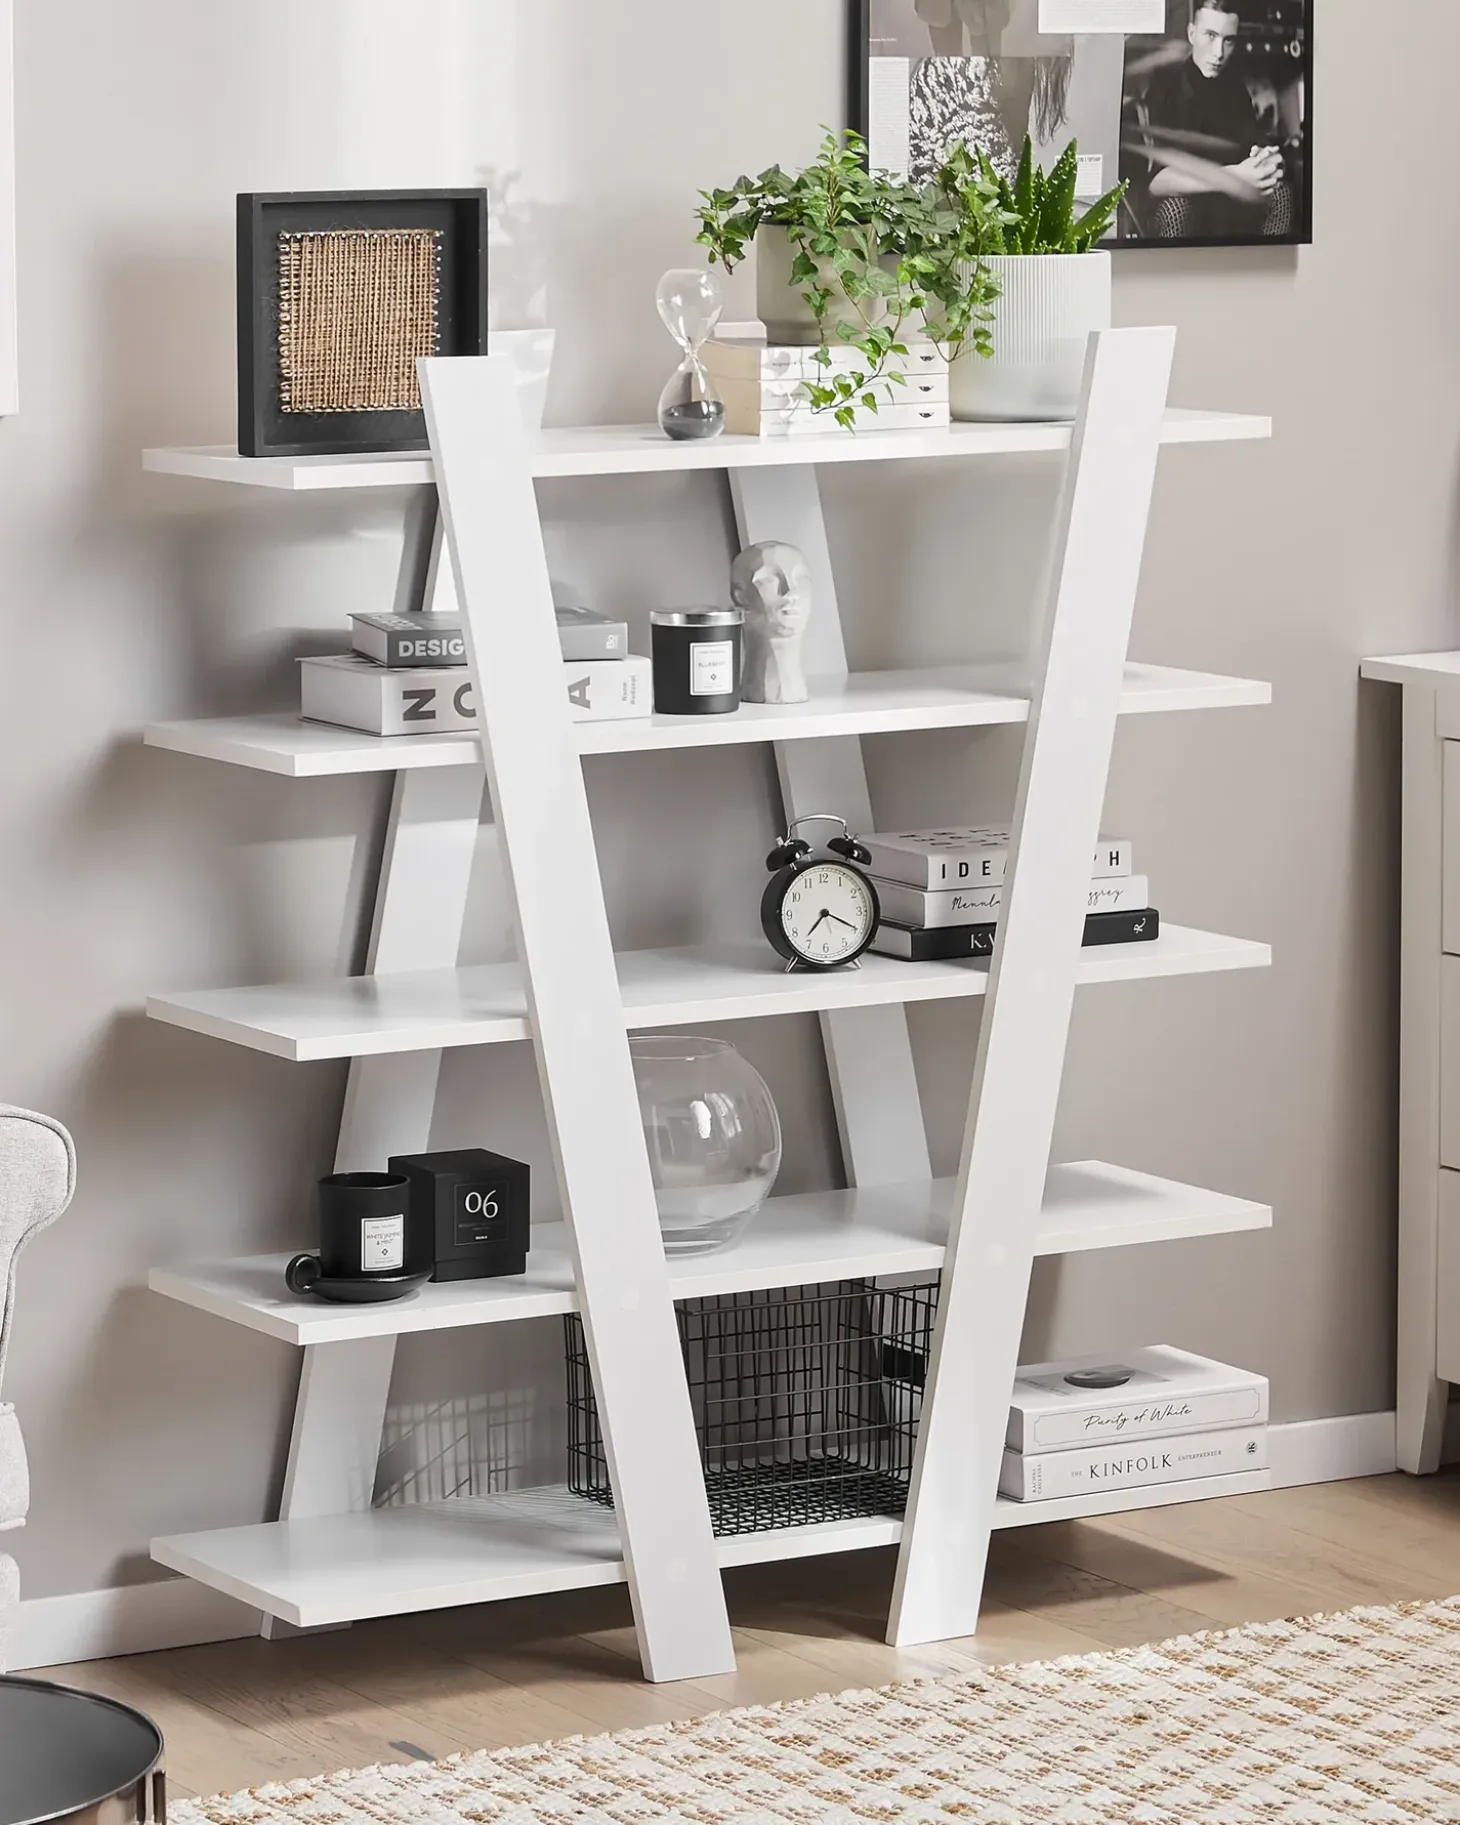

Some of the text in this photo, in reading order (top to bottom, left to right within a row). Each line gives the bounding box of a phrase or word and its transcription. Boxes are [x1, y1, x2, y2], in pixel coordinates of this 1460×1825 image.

[398, 638, 464, 657] DESIG
[804, 877, 812, 889] 11
[819, 872, 829, 884] 12
[838, 876, 842, 887] 1
[792, 891, 801, 903] 10
[850, 888, 857, 899] 2
[786, 909, 793, 921] 9
[856, 906, 863, 917] 3
[791, 927, 799, 938] 8
[806, 939, 812, 950] 7
[822, 942, 829, 953] 6
[841, 938, 848, 949] 5
[465, 1189, 498, 1218] 06
[1083, 1403, 1193, 1431] Purity of White
[1089, 1453, 1172, 1479] KINFOLK
